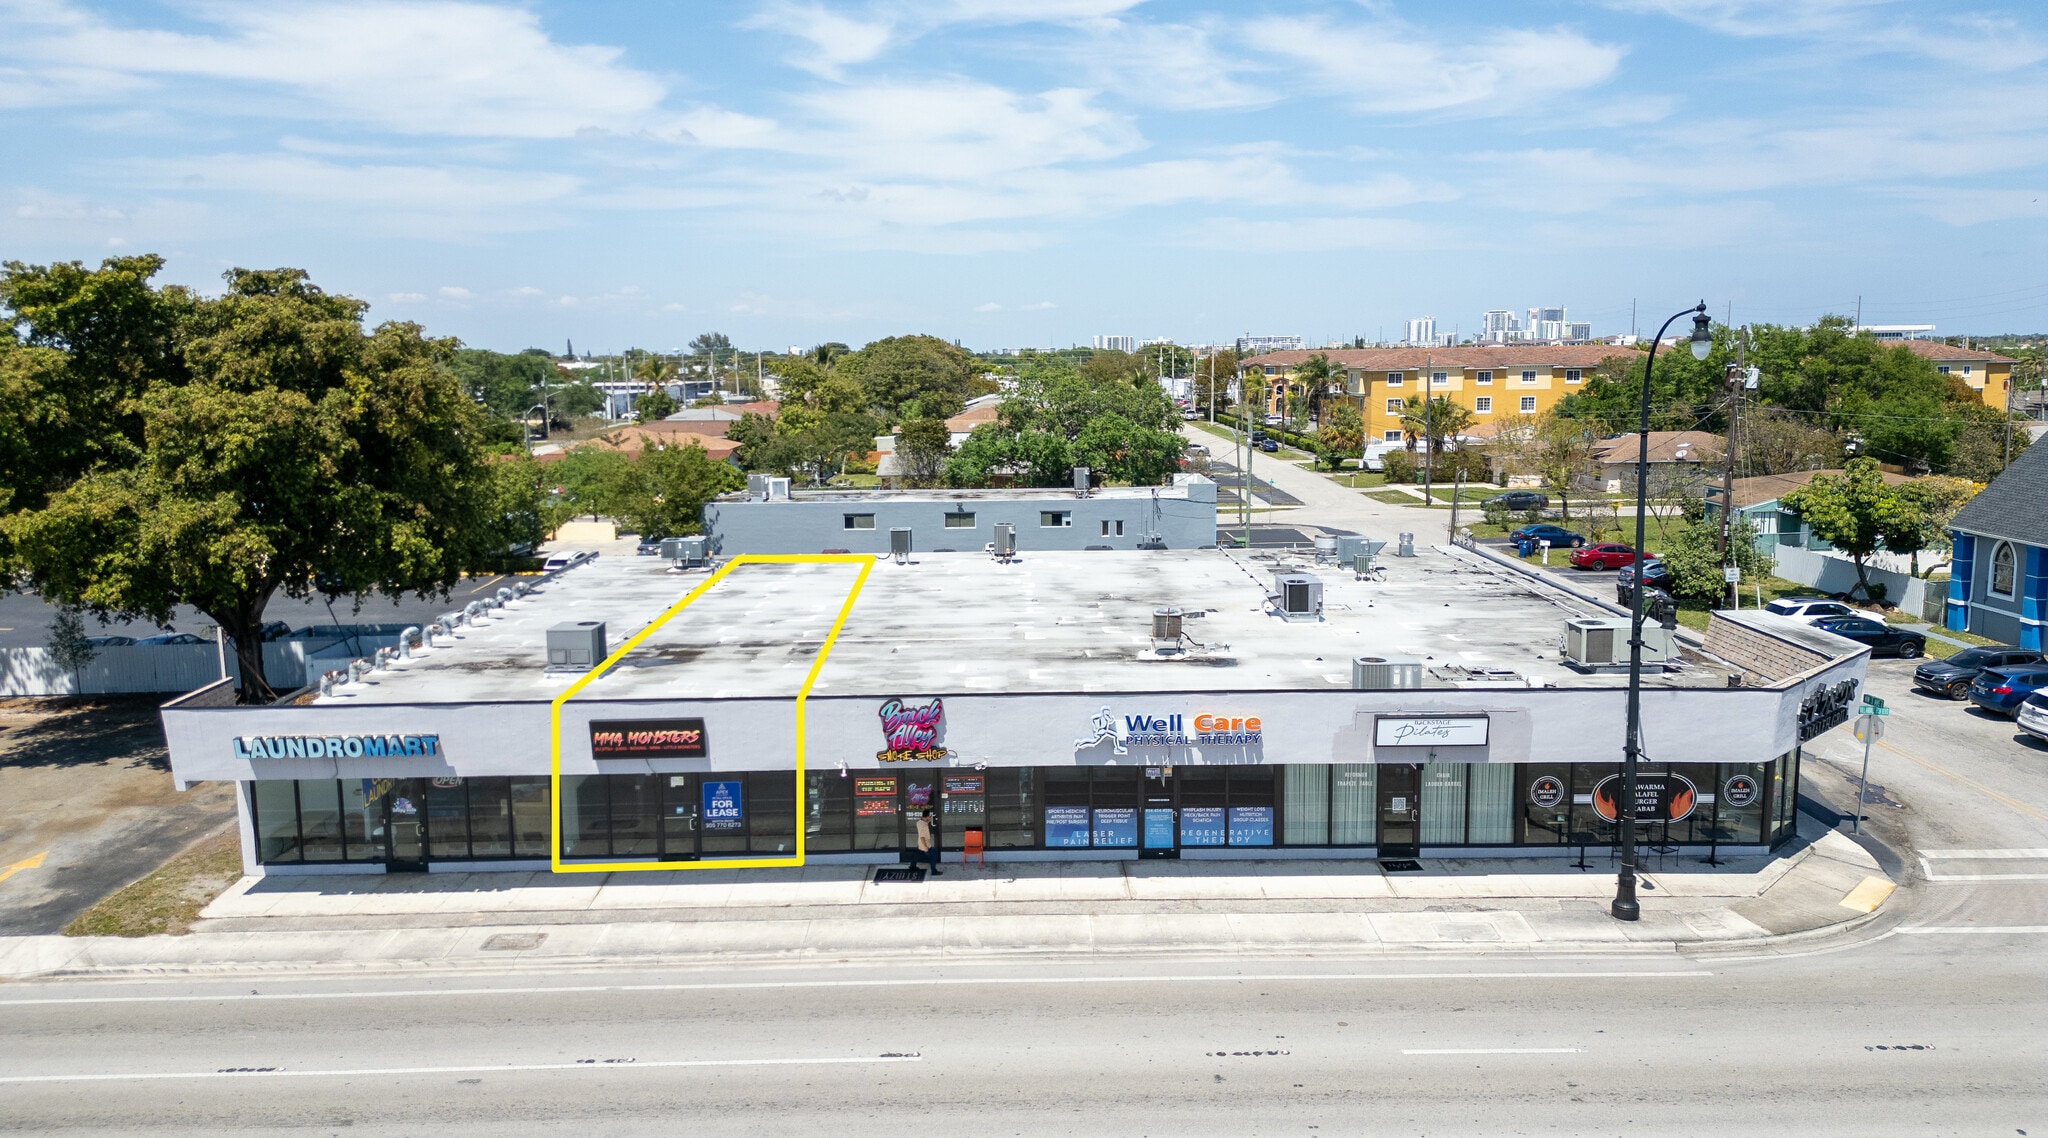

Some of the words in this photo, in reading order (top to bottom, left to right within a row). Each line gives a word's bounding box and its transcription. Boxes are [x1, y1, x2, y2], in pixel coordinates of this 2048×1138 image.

[880, 699, 941, 732] Back
[1124, 713, 1182, 732] Well
[1193, 713, 1262, 732] Care
[627, 730, 701, 745] MONSTERS
[888, 724, 936, 749] Alley
[1125, 734, 1192, 745] PHYSICAL
[1199, 733, 1262, 745] THERAPY
[1394, 723, 1472, 745] Pilates
[232, 733, 440, 760] LAUNDROMART
[877, 750, 913, 761] SMOKE
[916, 749, 947, 761] SHOP
[711, 800, 733, 808] FOR
[706, 808, 739, 817] LEASE
[1076, 830, 1114, 838] LASER
